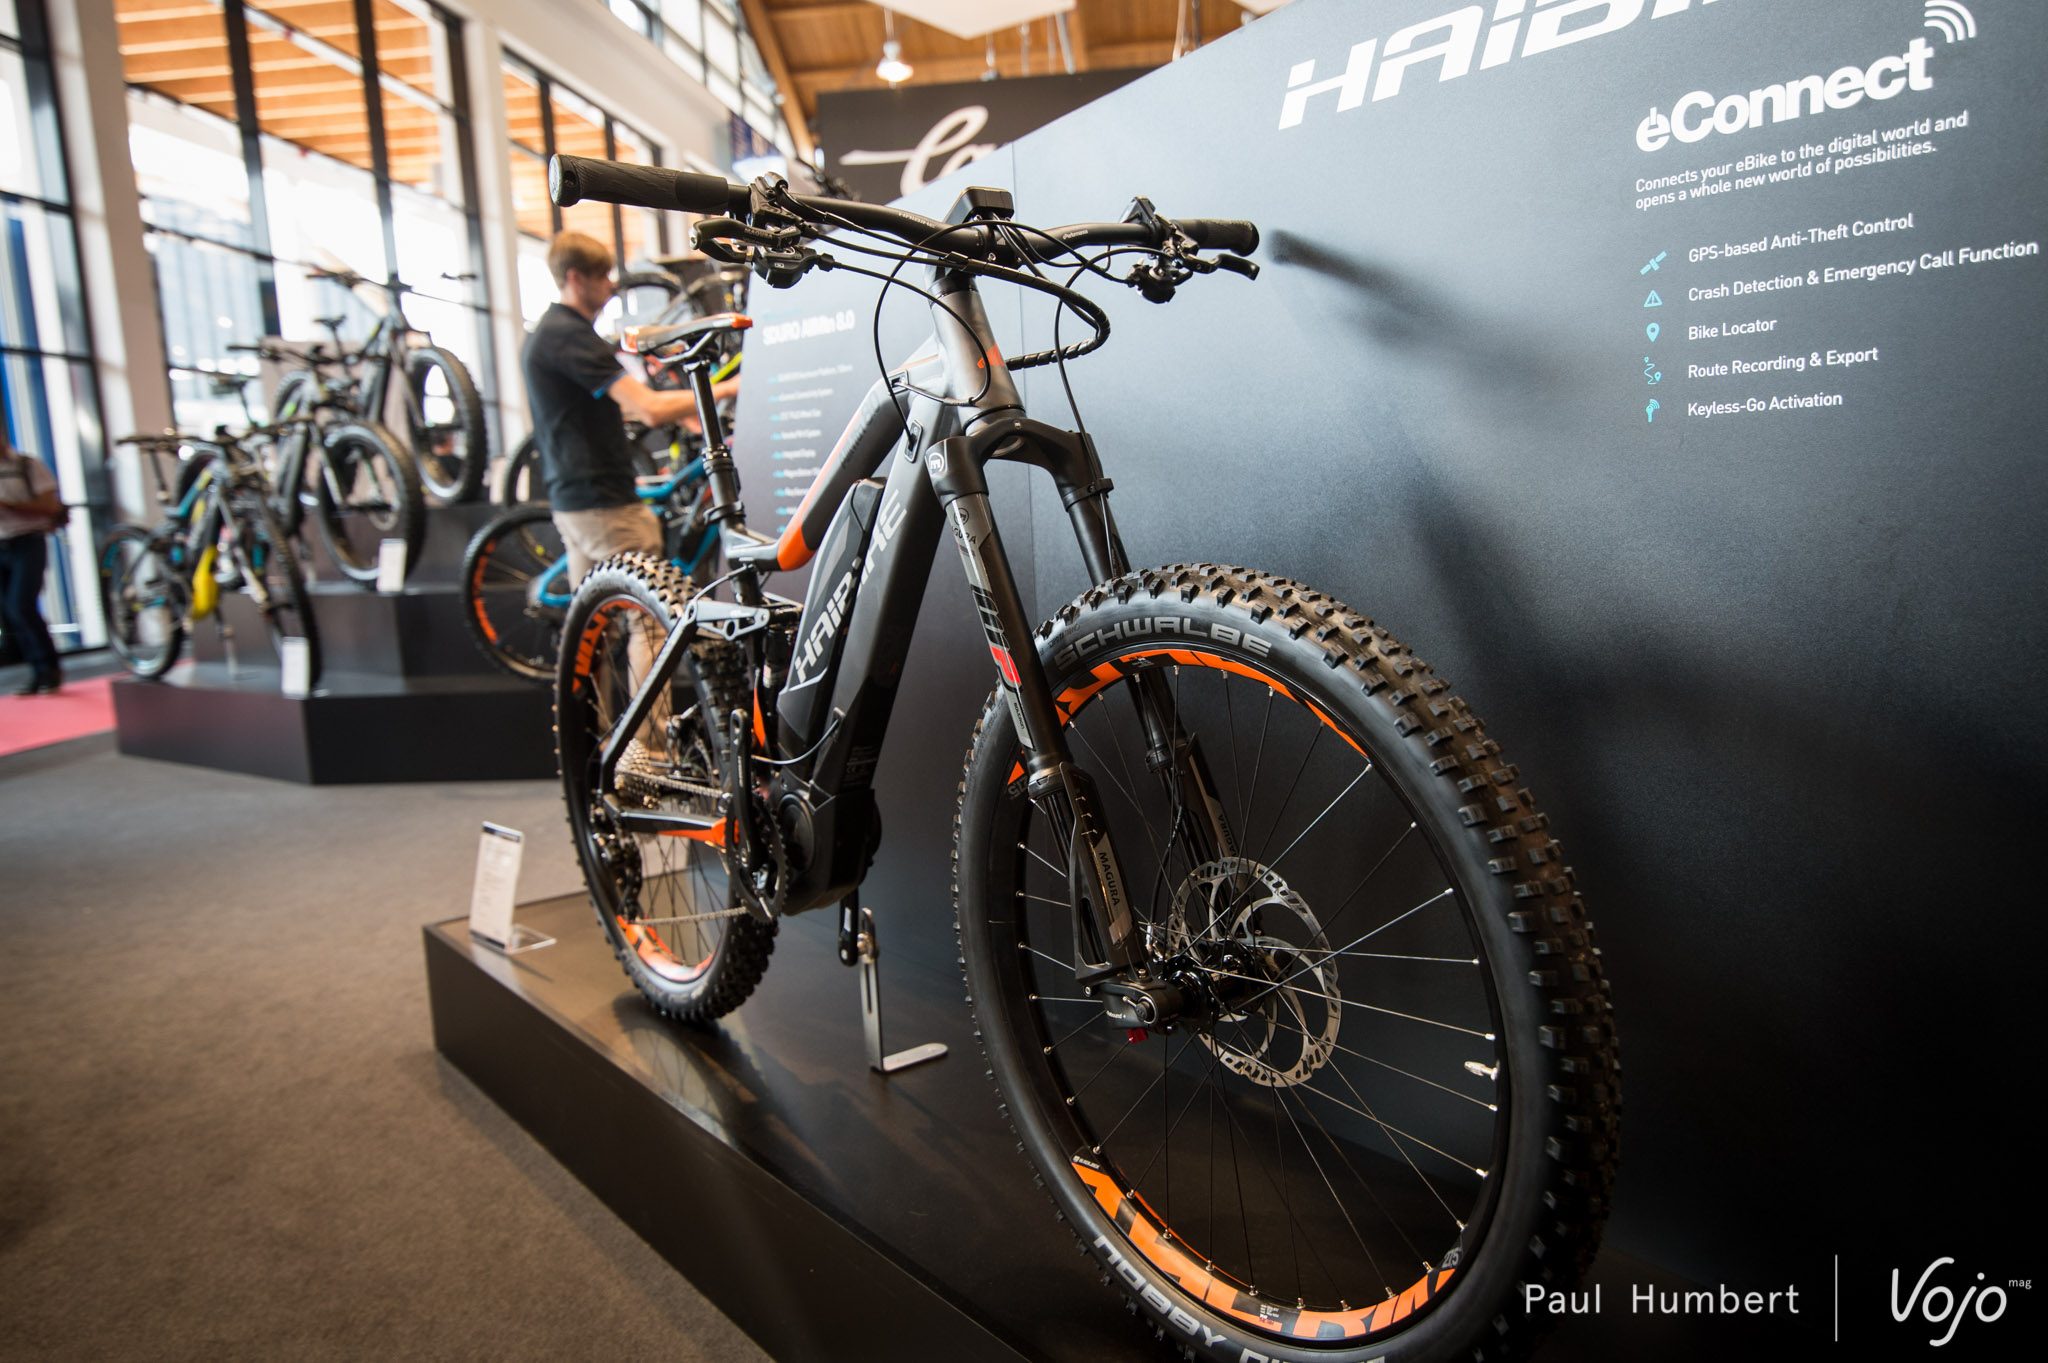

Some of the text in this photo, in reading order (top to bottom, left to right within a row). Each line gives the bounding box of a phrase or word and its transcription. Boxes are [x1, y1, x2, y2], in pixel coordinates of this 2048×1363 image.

[1278, 0, 1718, 130] HAIB
[1635, 37, 1934, 152] eConnect
[1635, 110, 1968, 193] Connects your eBike to the digital world and
[1635, 139, 1938, 211] opens a whole new world of possibilities.
[1688, 213, 1914, 263] GPS-based Anti-Theft Control
[1688, 240, 2039, 302] Crash Detection & Emergency Call Function
[1688, 319, 1778, 340] Bike Locator
[1688, 347, 1879, 378] Route Recording & Export
[1687, 392, 1843, 418] Keyless-Go Activation
[1053, 616, 1272, 672] SCHWALBE
[1099, 851, 1122, 907] MAGURA
[1094, 1235, 1227, 1347] NOBBY
